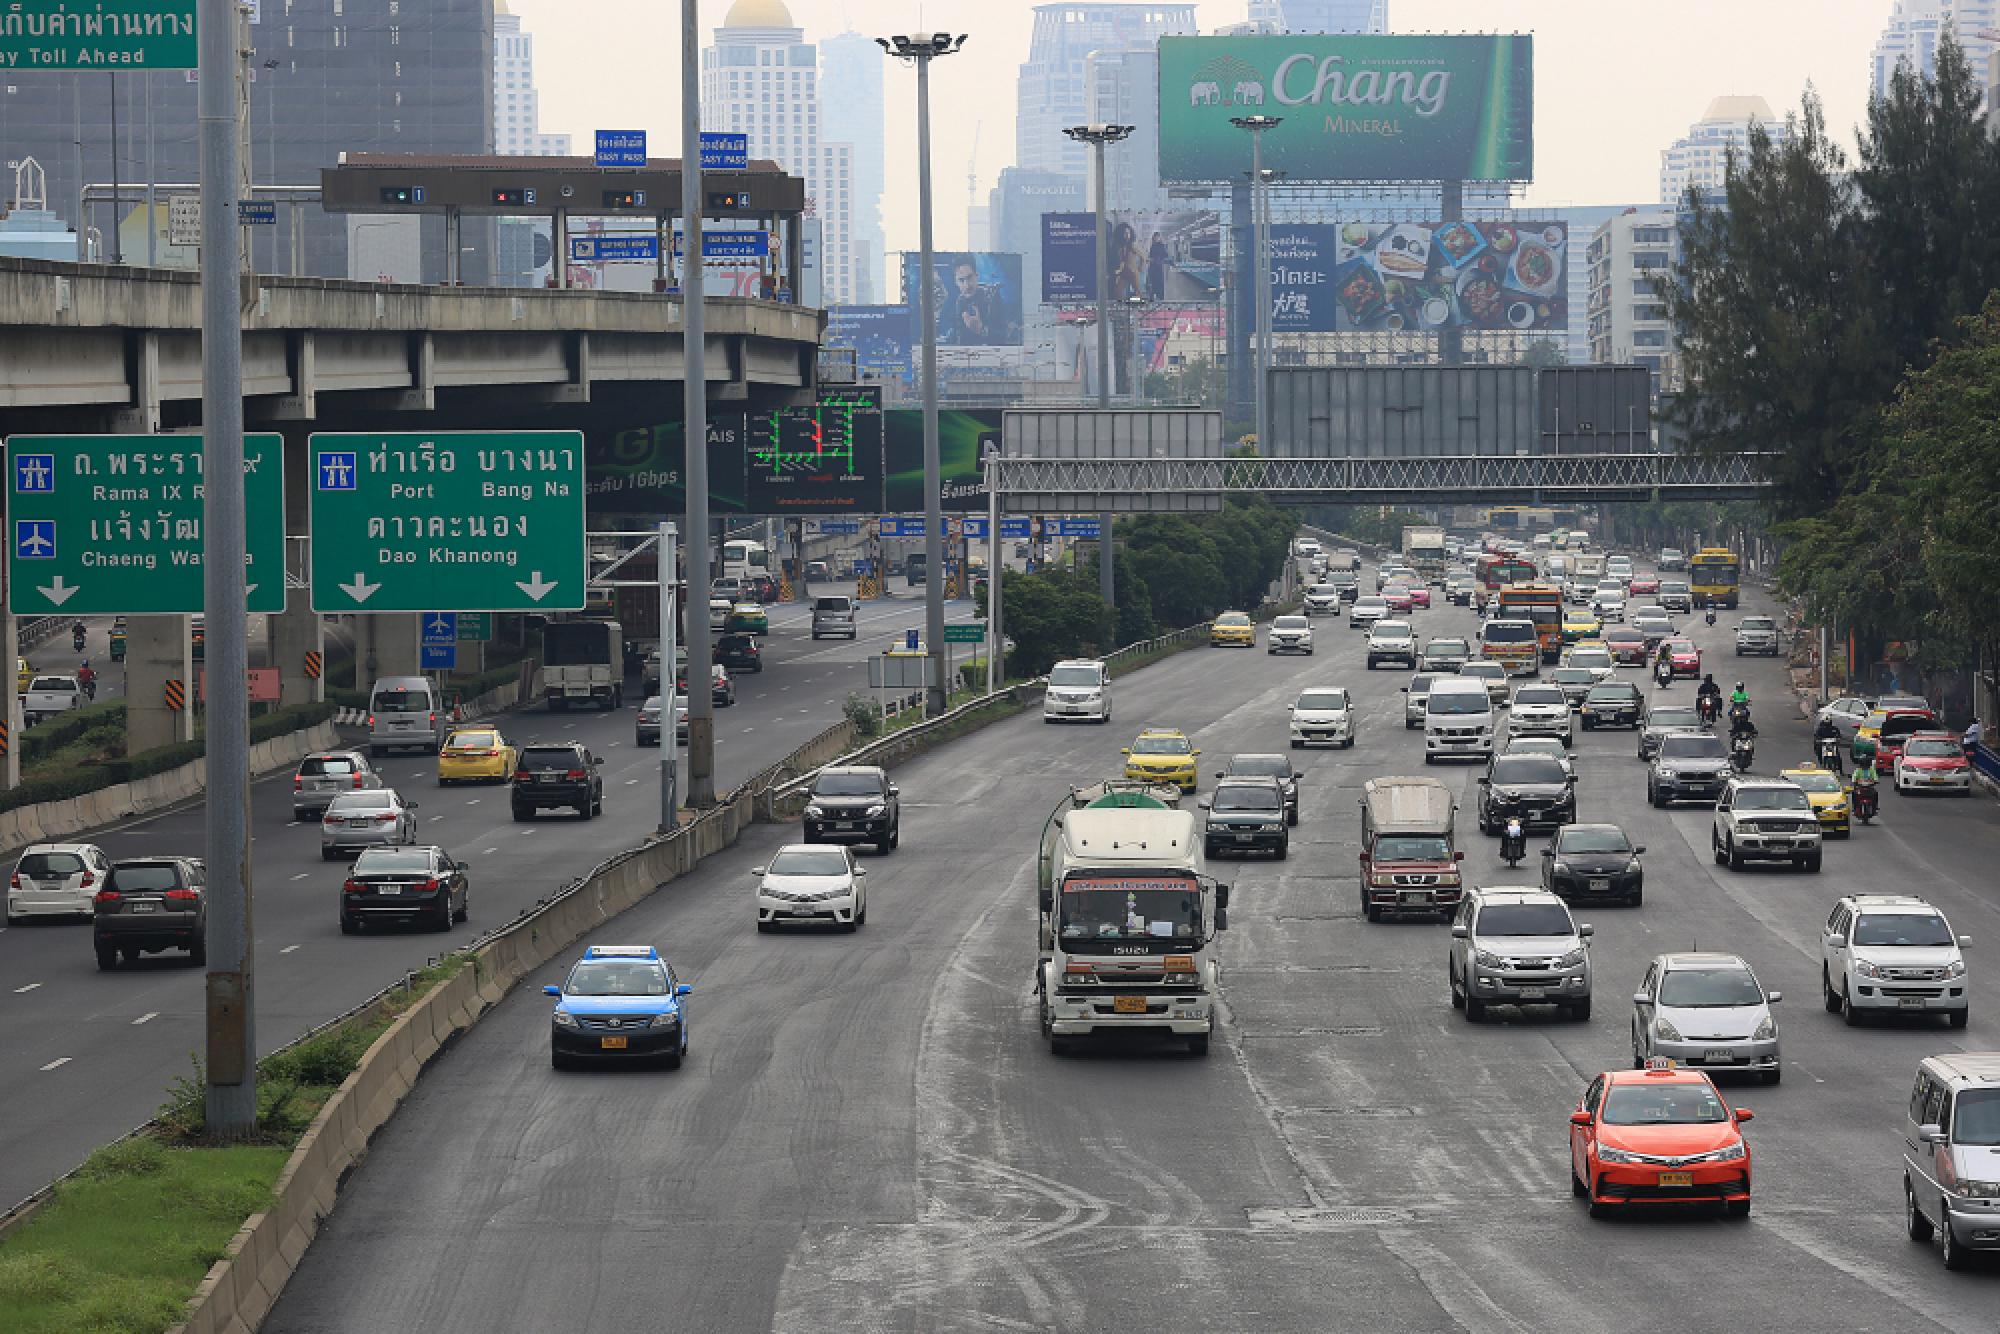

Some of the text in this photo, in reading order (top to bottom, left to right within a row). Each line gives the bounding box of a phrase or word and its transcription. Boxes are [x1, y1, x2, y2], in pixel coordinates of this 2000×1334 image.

[29, 48, 66, 64] Toll
[77, 48, 144, 64] Ahead
[1272, 53, 1450, 115] Chang
[598, 152, 645, 163] EASY PASS
[724, 154, 746, 164] PASS
[1021, 185, 1078, 195] NOVOTEL
[708, 430, 735, 443] AIS
[367, 441, 573, 473] ท่าเรือ บางนา
[628, 469, 678, 489] 1Gbps
[93, 485, 149, 501] Rama
[162, 485, 182, 500] IX
[391, 483, 434, 499] Port
[482, 481, 569, 500] Bang Na
[367, 515, 528, 539] ดาวคะนอง
[81, 551, 157, 570] Chaeng
[379, 547, 518, 567] Dao Khanong
[1113, 946, 1149, 955] ISUZU
